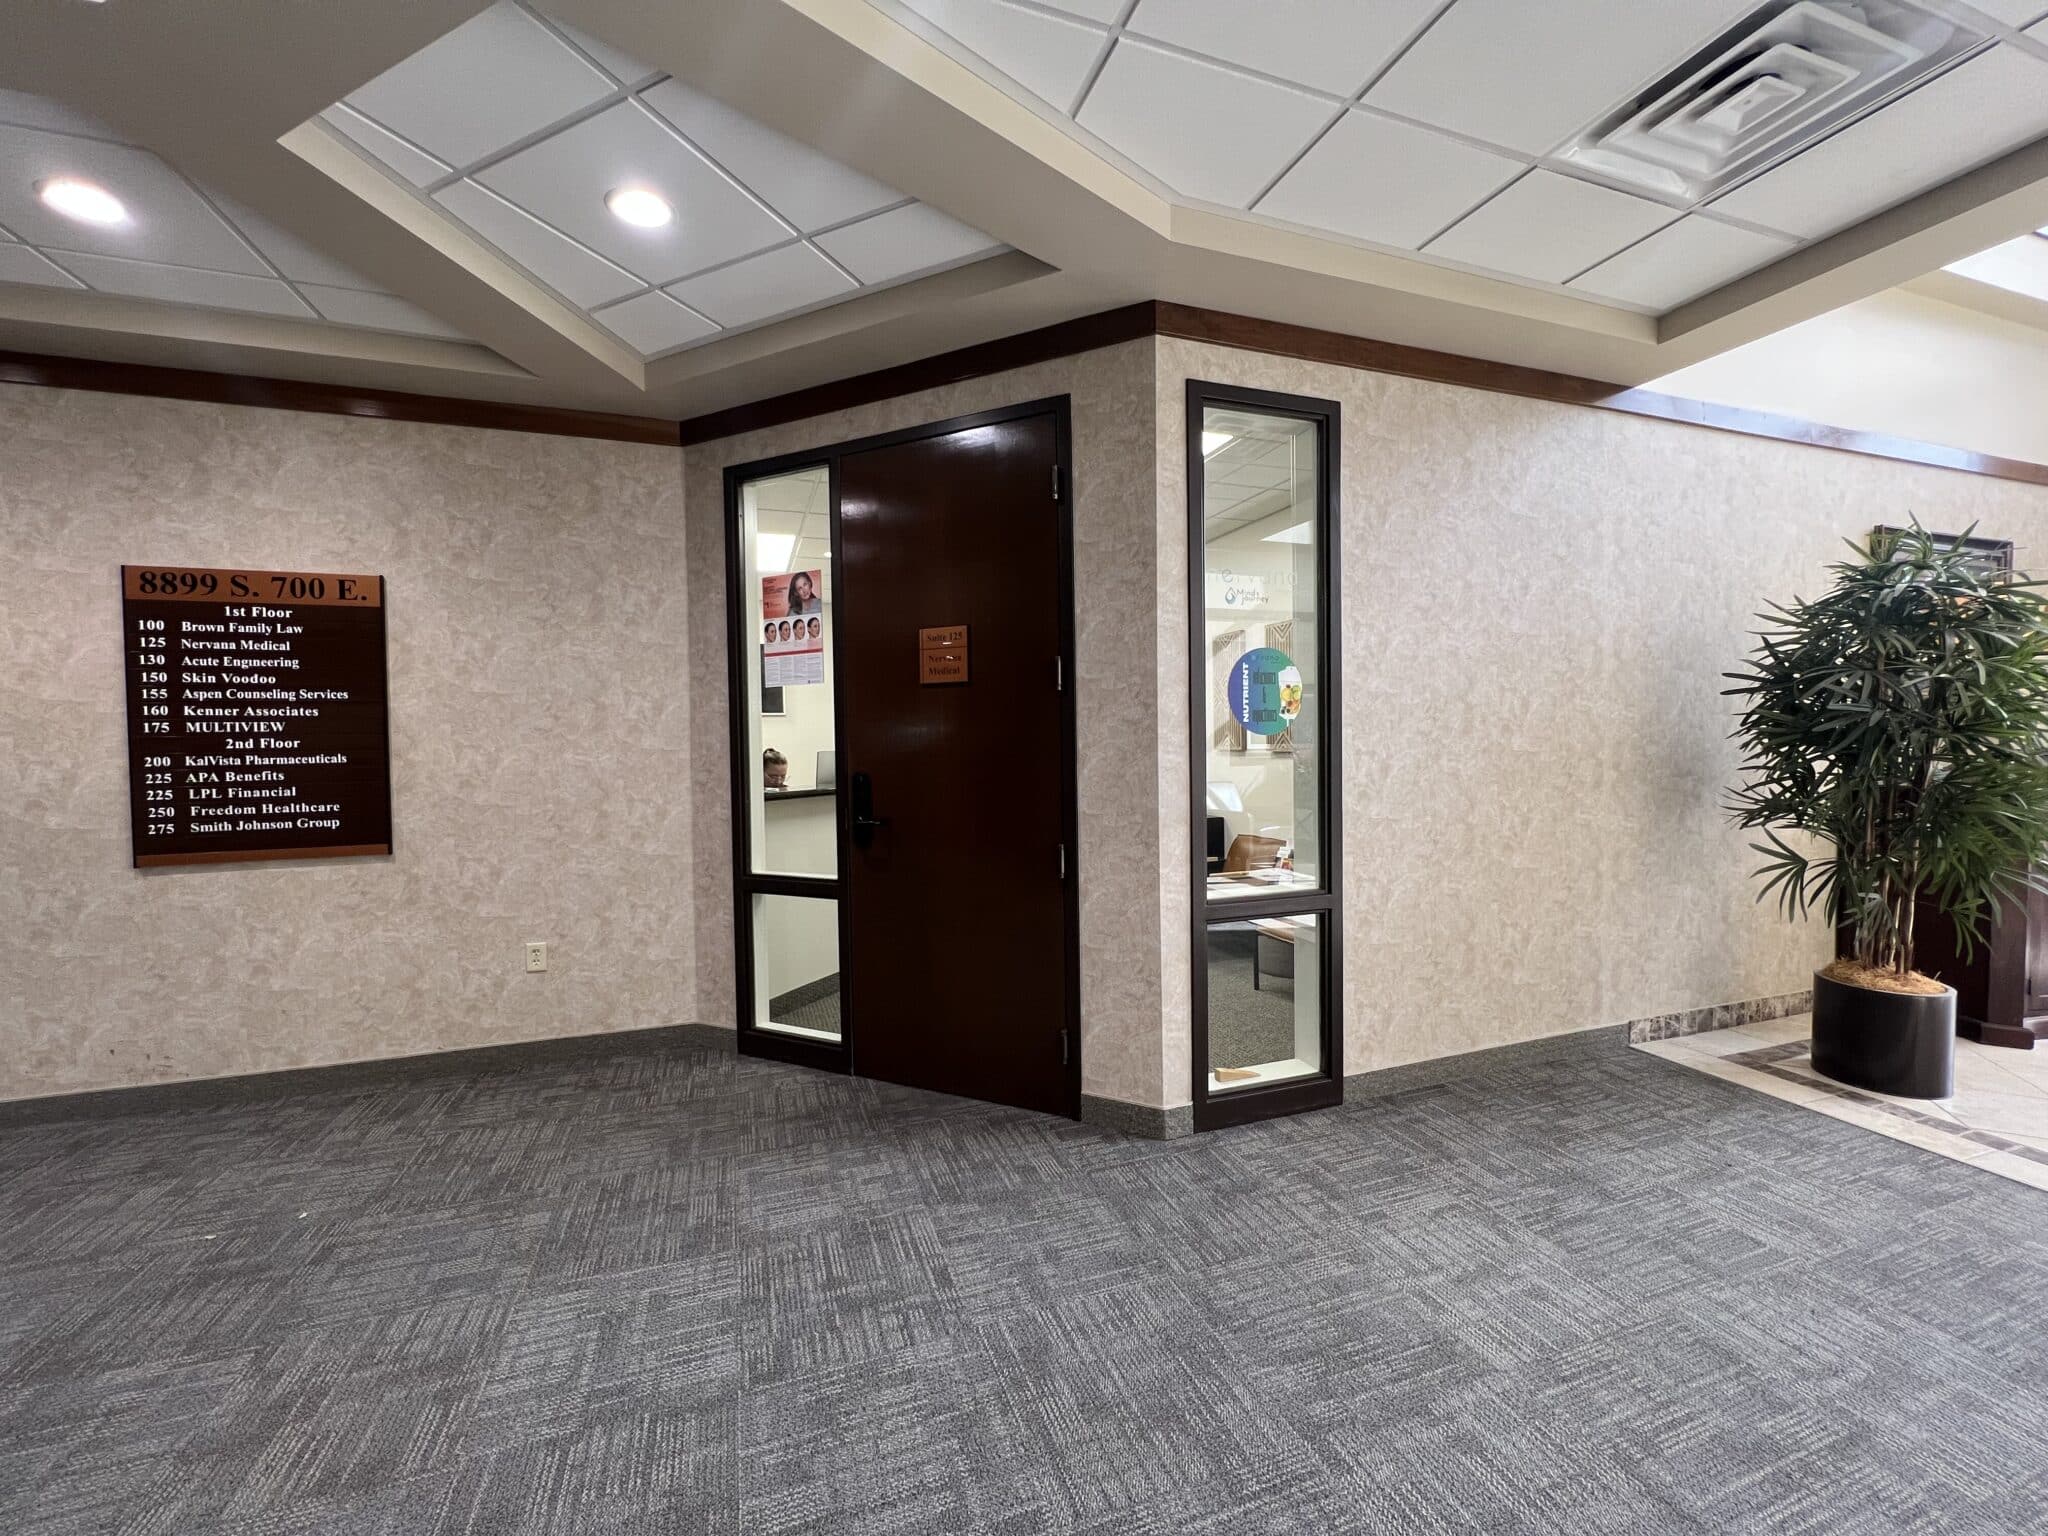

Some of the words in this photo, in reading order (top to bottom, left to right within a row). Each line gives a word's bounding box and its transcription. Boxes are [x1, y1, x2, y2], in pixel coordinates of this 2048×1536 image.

[140, 571, 218, 595] 8899
[231, 575, 259, 597] S.
[271, 577, 324, 599] 700
[337, 580, 366, 600] E.
[224, 606, 246, 617] 1st
[251, 607, 292, 619] Floor
[138, 620, 164, 631] 100
[181, 621, 224, 633] Brown
[228, 623, 272, 636] Family
[276, 624, 303, 634] Law
[927, 632, 946, 641] Suite
[140, 637, 166, 648] 125
[180, 639, 236, 650] Nervana
[240, 640, 290, 651] Medical
[139, 655, 165, 665] 130
[181, 656, 219, 667] Acute
[223, 657, 299, 670] Engineering
[141, 672, 167, 683] 150
[181, 673, 216, 684] Skin
[221, 673, 276, 684] Voodoo
[928, 666, 961, 677] Medical
[141, 689, 167, 700] 155
[182, 689, 222, 702] Aspen
[225, 689, 296, 702] Counseling
[299, 689, 348, 700] Services
[1242, 661, 1250, 723] NUTRIENT
[143, 706, 168, 716] 160
[183, 706, 239, 717] Kenner
[243, 706, 318, 717] Associates
[143, 722, 169, 734] 175
[185, 722, 285, 733] MULTIVIEW
[225, 739, 253, 750] 2nd
[259, 738, 300, 749] Floor
[144, 757, 170, 768] 200
[185, 756, 241, 767] KalVista
[245, 754, 347, 766] Pharmaceuticals
[145, 774, 171, 785] 225
[185, 773, 219, 783] APA
[225, 771, 284, 782] Benefits
[146, 790, 173, 801] 225
[189, 789, 222, 800] LPL
[227, 787, 295, 799] Financial
[148, 807, 174, 818] 250
[190, 805, 256, 817] Freedom
[261, 803, 339, 814] Healthcare
[148, 824, 174, 835] 275
[190, 822, 232, 833] Smith
[235, 821, 292, 831] Johnson
[296, 818, 339, 830] Group
